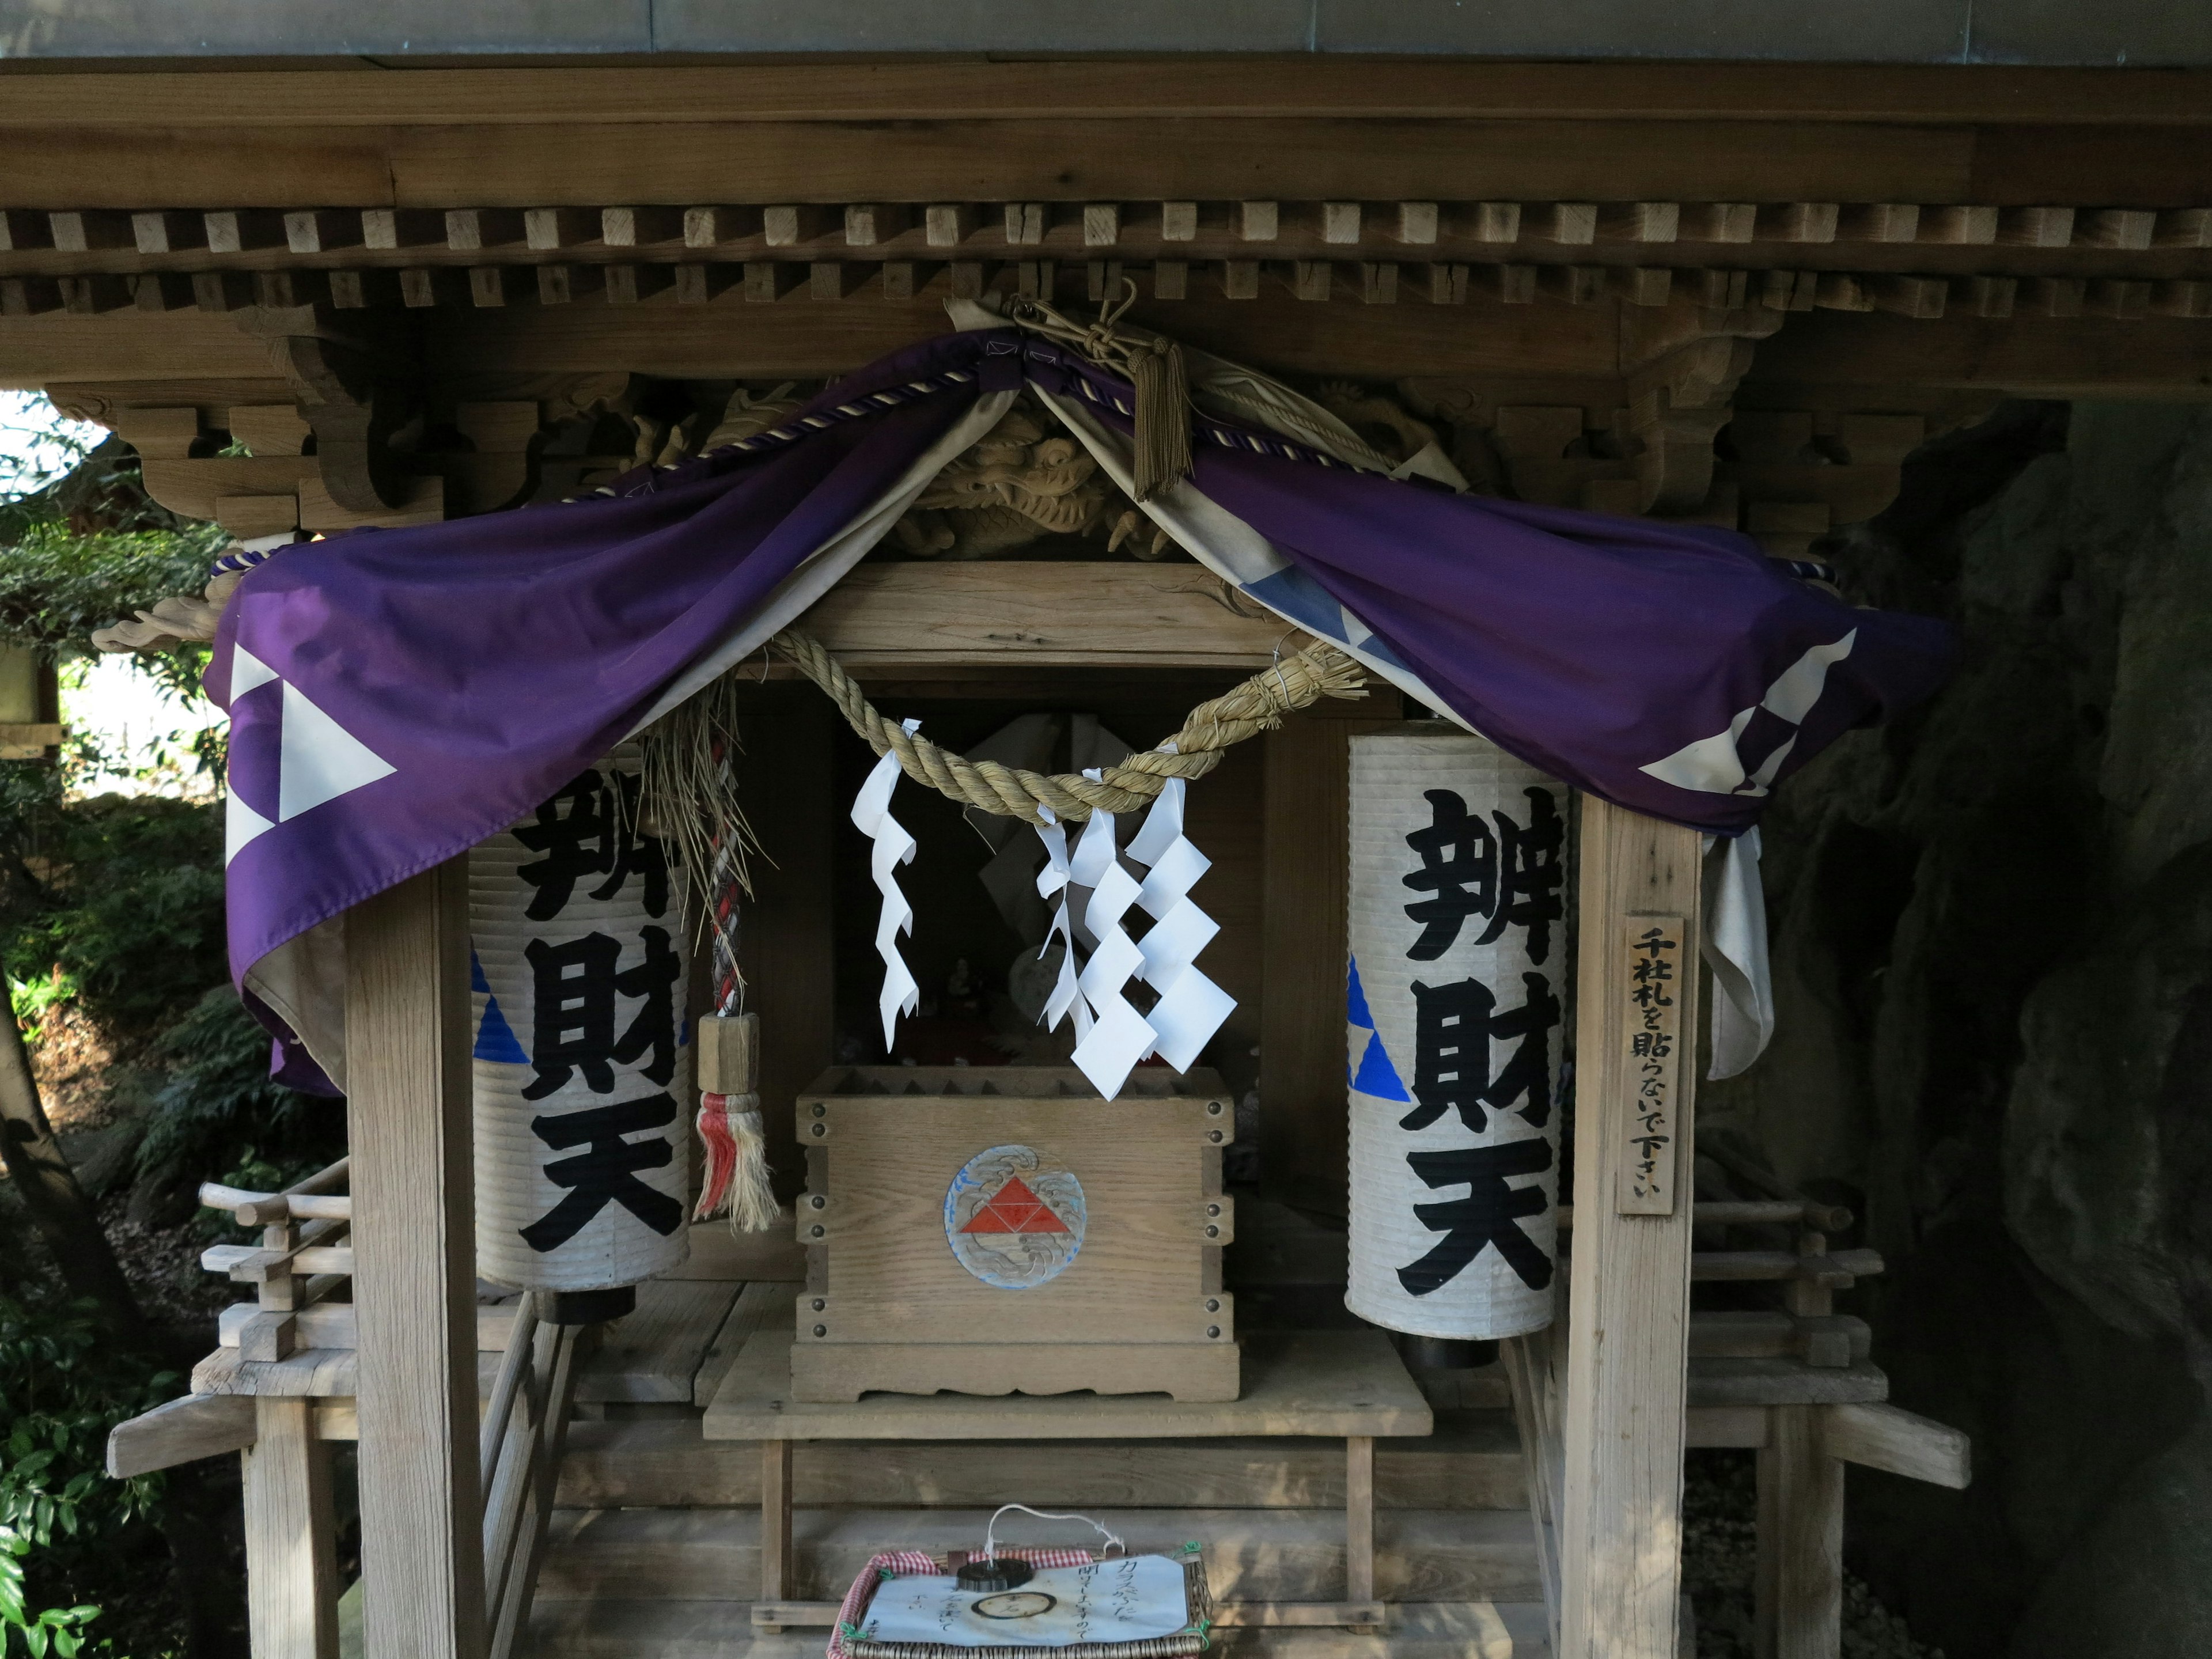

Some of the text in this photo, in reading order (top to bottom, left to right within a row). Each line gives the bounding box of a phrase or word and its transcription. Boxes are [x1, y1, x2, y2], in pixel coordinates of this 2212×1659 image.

[1630, 927, 1676, 1198] 千社札を貼らないで下さい
